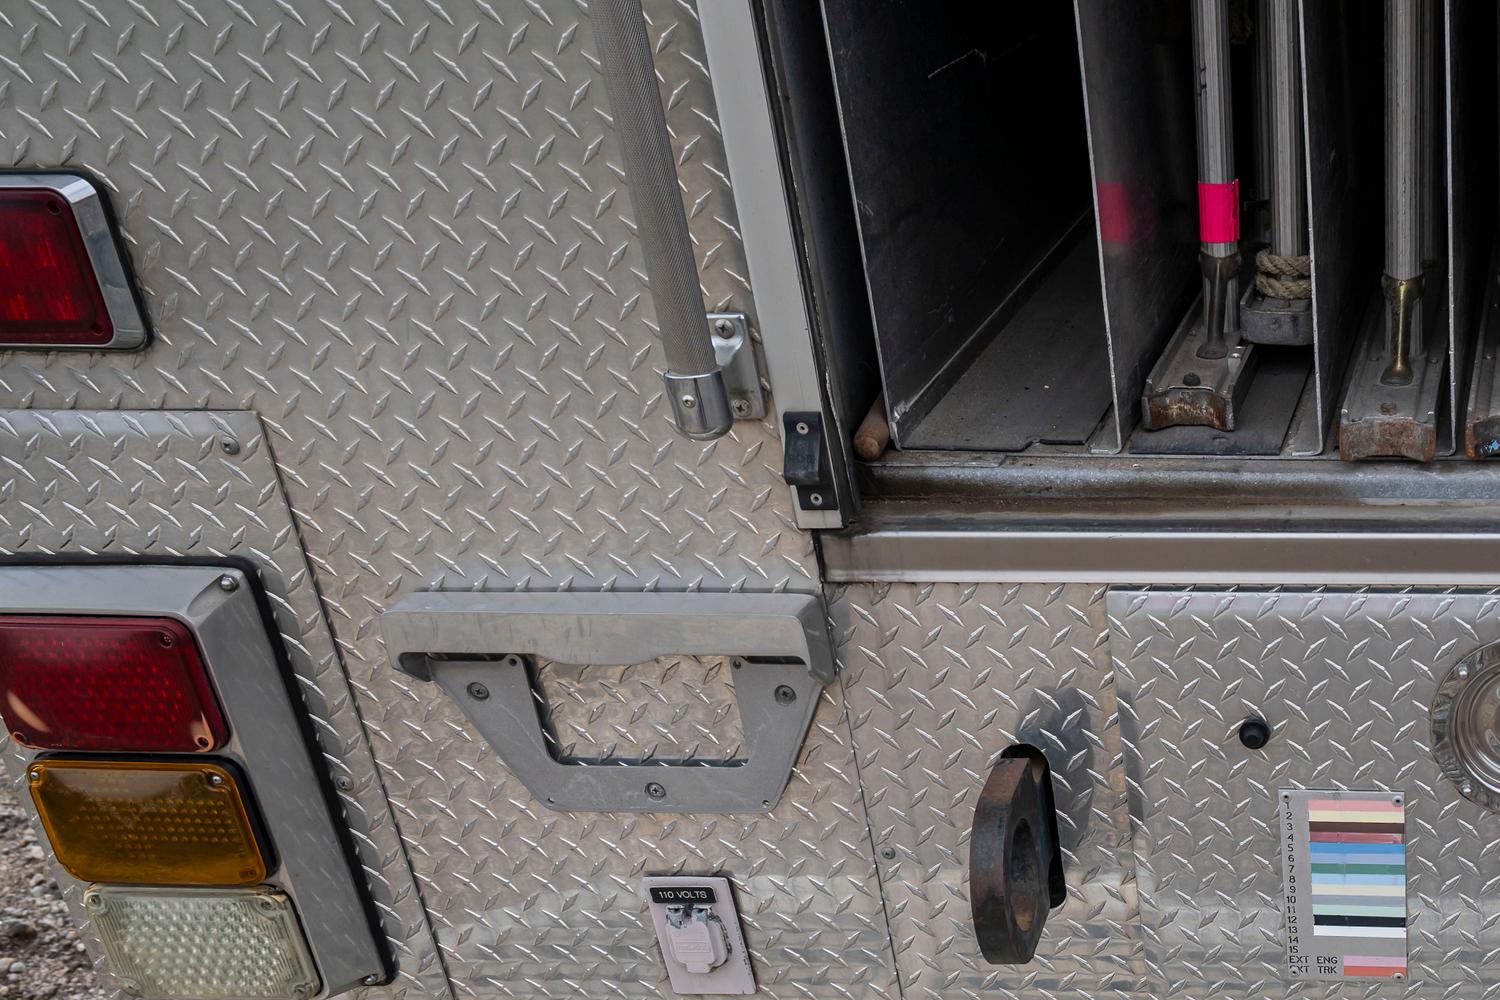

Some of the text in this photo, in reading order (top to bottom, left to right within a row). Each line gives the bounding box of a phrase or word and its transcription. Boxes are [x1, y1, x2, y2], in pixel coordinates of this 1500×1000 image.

[1286, 811, 1293, 820] 2
[1286, 822, 1293, 831] 3
[1287, 833, 1294, 841] 4
[1287, 843, 1294, 852] 5
[1288, 854, 1295, 862] 6
[1288, 864, 1295, 873] 7
[1289, 875, 1296, 883] 8
[1289, 885, 1296, 893] 9
[658, 891, 708, 899] 110 VOLTS
[1286, 895, 1297, 903] 10
[1286, 905, 1296, 914] 11
[1287, 915, 1297, 924] 12
[1288, 926, 1298, 934] 13
[1288, 936, 1299, 944] 14
[1289, 945, 1299, 954] 15
[1289, 955, 1338, 964] EXT ENG
[1317, 965, 1337, 974] TRK
